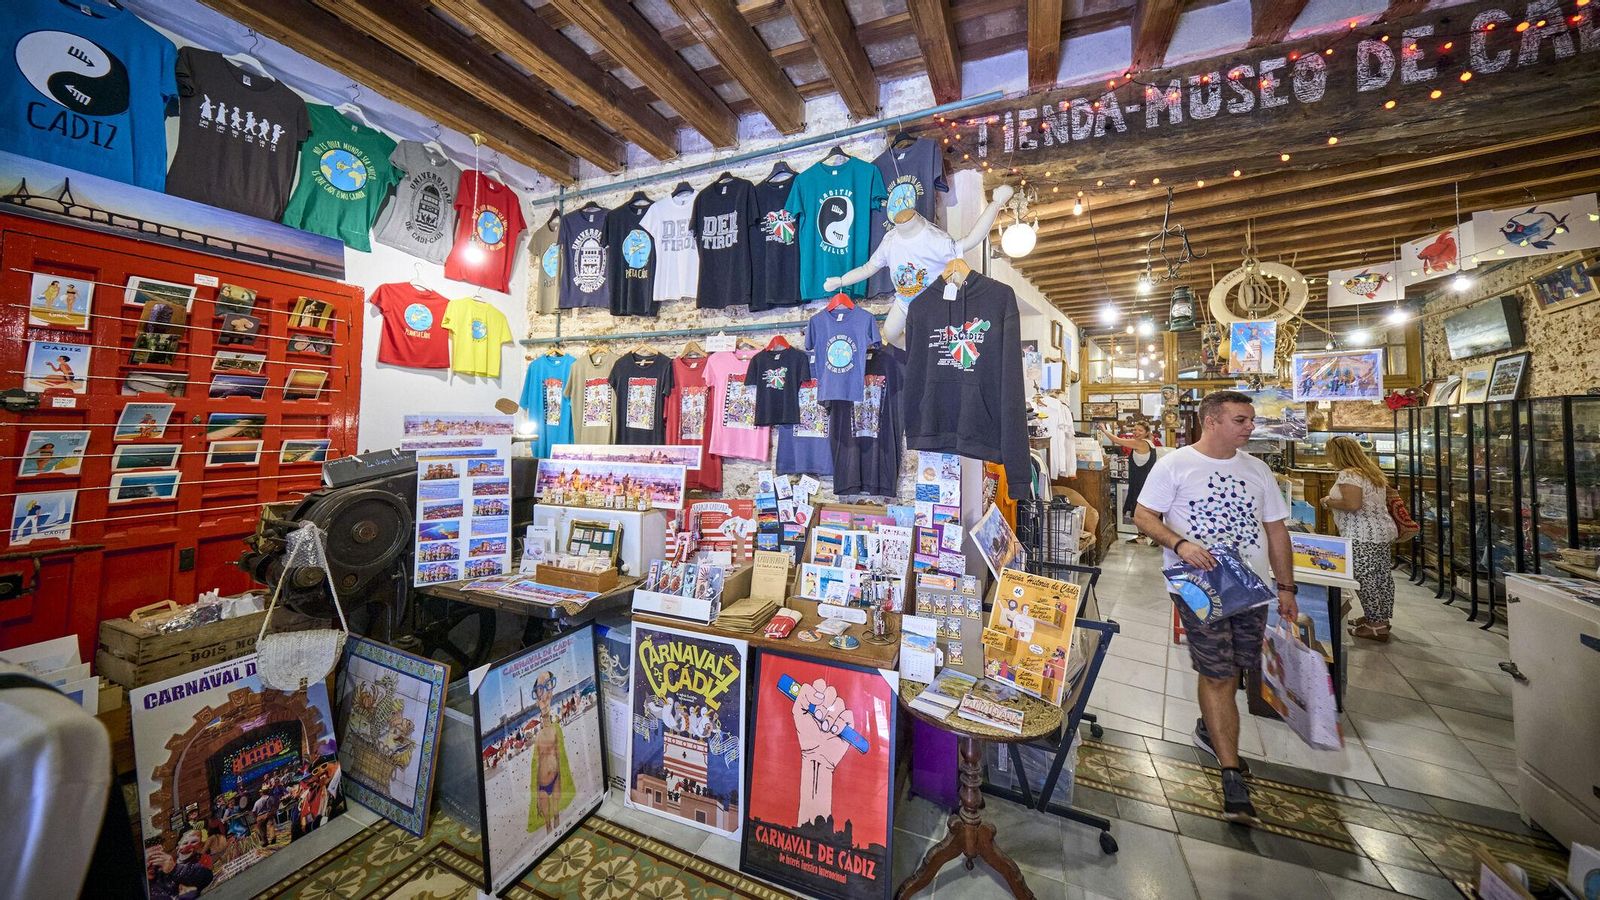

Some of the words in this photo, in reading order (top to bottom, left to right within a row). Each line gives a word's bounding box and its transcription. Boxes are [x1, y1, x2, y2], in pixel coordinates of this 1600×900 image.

[975, 52, 1328, 157] TIENDA-MUSEO
[1356, 24, 1438, 92] DE
[27, 101, 118, 149] CADIZ
[410, 172, 452, 204] UNIVERSIDAD
[405, 221, 412, 231] DE
[191, 645, 226, 663] BOIS
[639, 640, 726, 697] CARNAVAL
[653, 667, 663, 682] DE
[143, 667, 243, 710] CARNAVAL
[663, 656, 740, 710] CÁDIZ
[755, 825, 813, 859] CARNAVAL
[818, 844, 834, 865] DE
[838, 850, 876, 880] CÁDIZ
